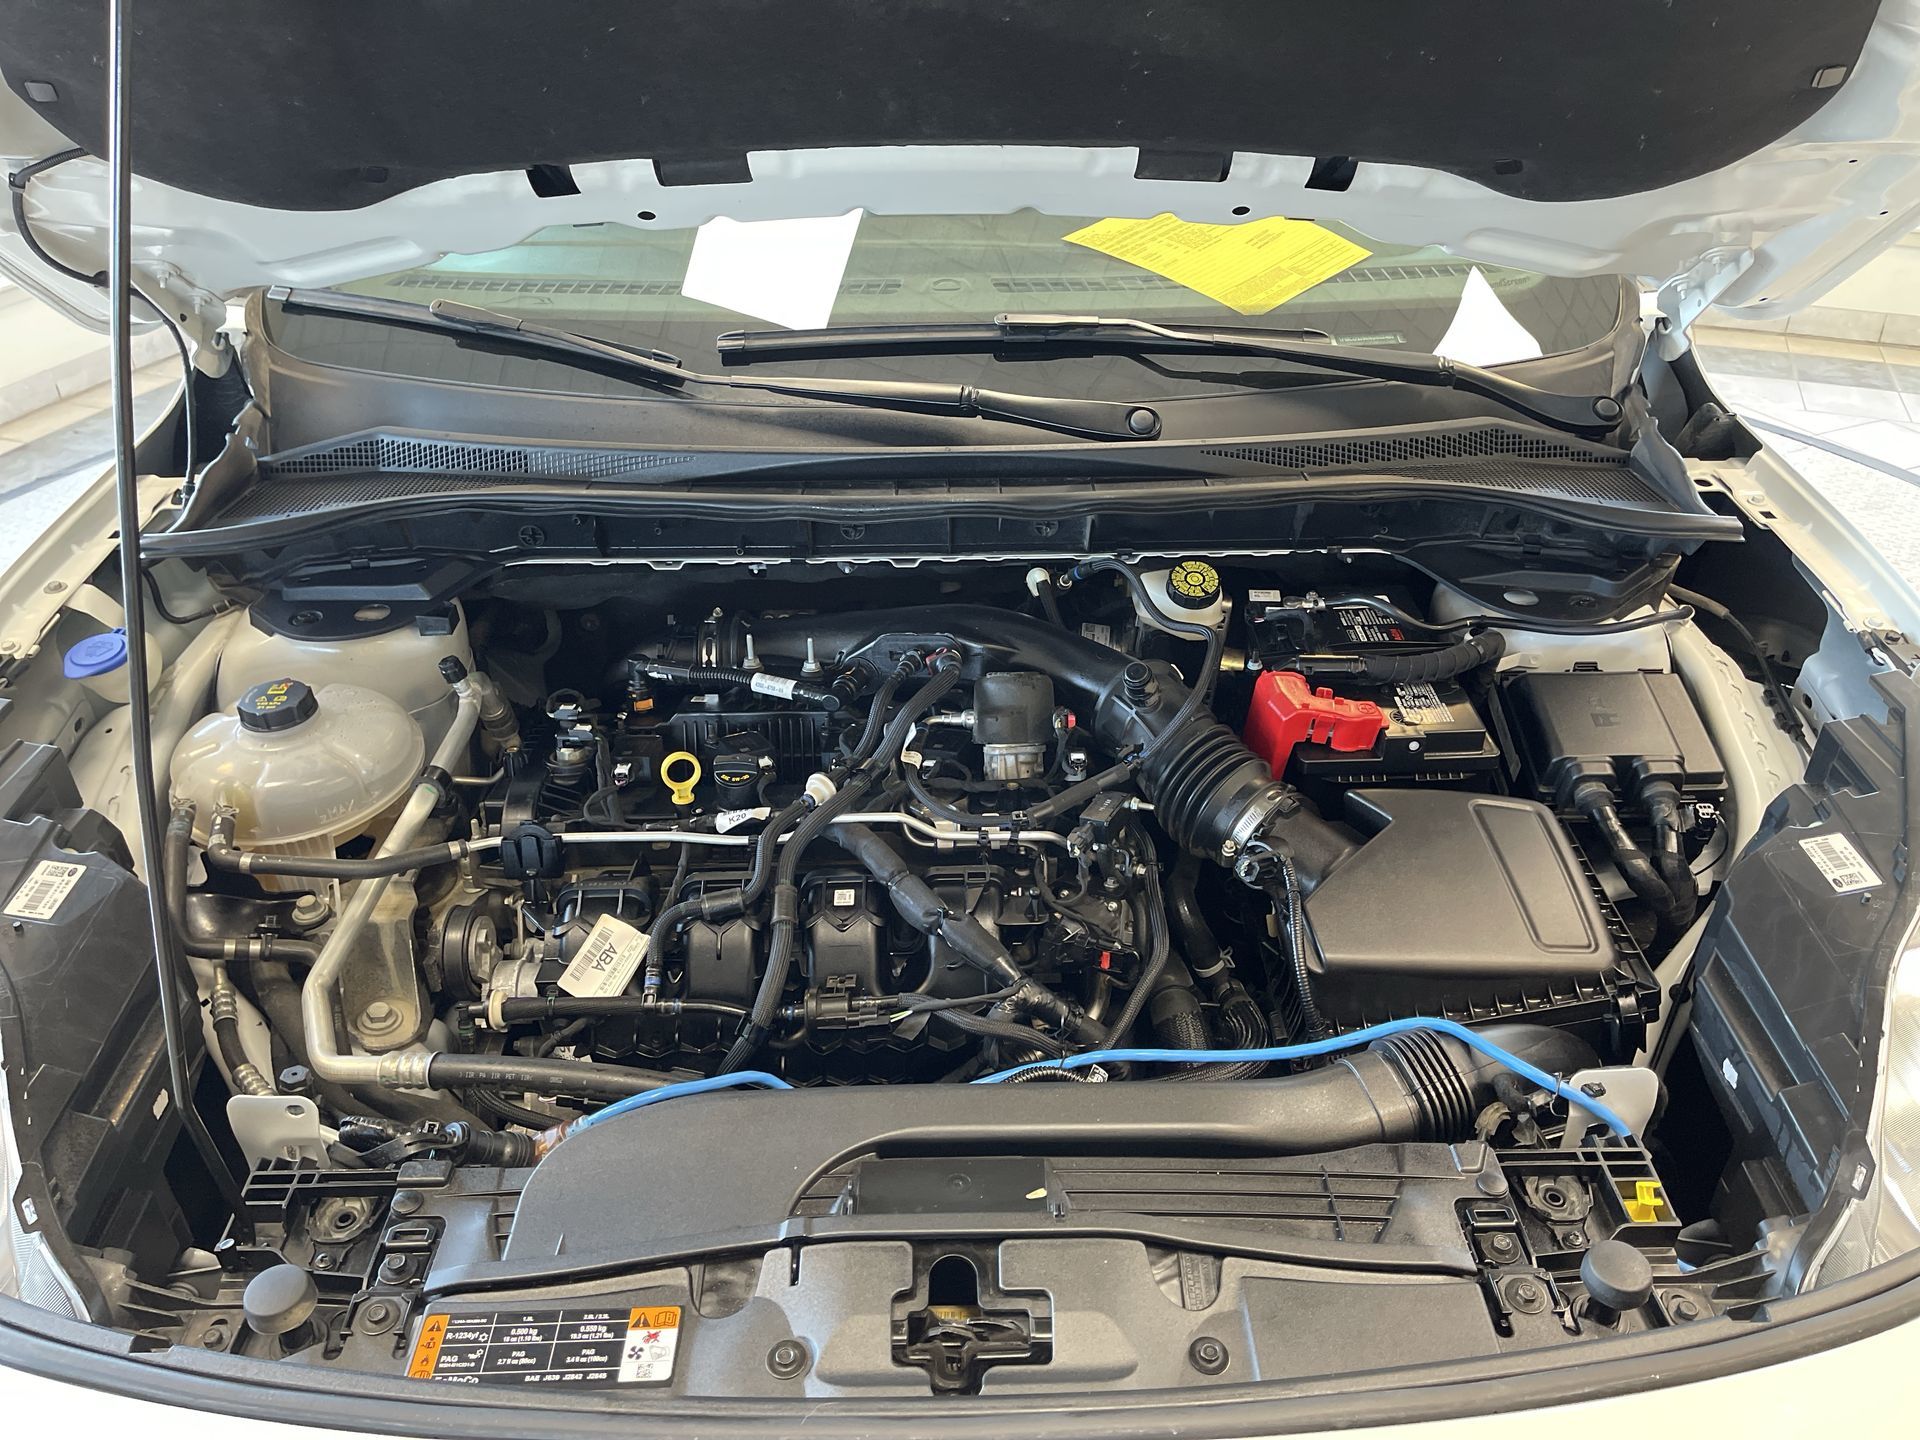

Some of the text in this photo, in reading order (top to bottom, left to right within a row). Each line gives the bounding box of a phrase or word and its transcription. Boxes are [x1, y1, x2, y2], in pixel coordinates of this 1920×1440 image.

[728, 813, 747, 825] K20
[591, 942, 618, 972] ABA
[529, 1328, 538, 1336] kg
[597, 1325, 607, 1333] kg
[446, 1331, 480, 1341] R-1234yf
[440, 1355, 459, 1363] PAG
